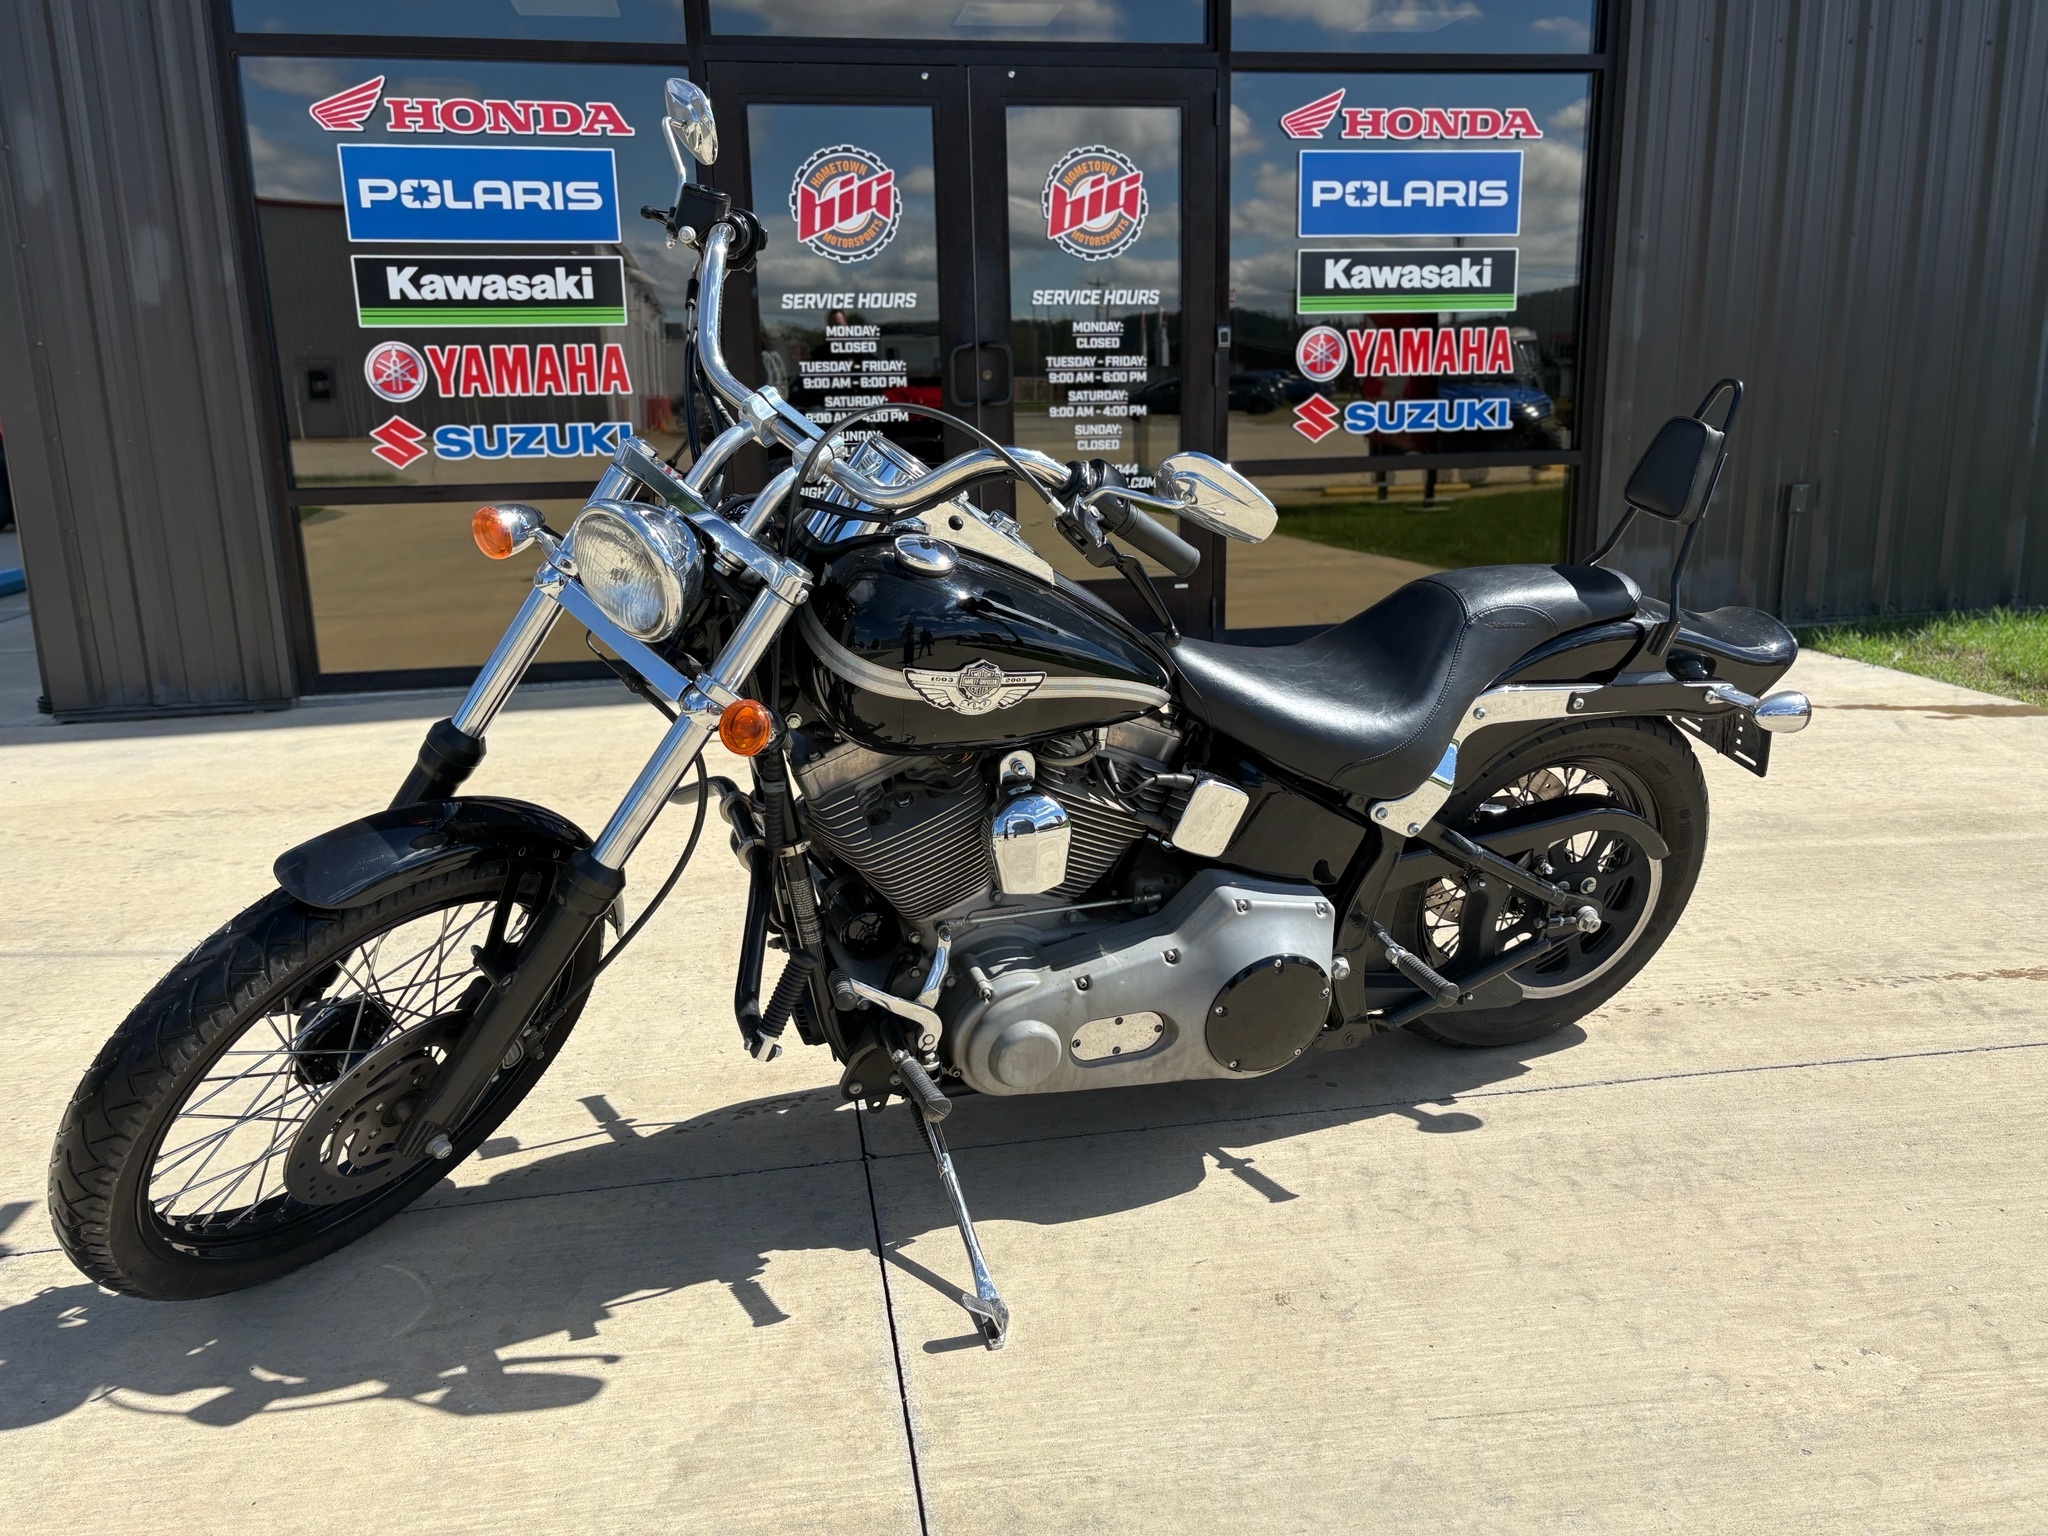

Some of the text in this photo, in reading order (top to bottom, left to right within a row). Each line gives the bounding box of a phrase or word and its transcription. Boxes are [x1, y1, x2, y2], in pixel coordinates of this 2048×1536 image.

[384, 98, 635, 137] HONDA
[1341, 107, 1543, 140] HONDA
[810, 160, 868, 189] HOMETOWN
[1062, 160, 1119, 187] HOMETOWN
[358, 178, 603, 211] POLARIS
[1312, 180, 1509, 208] POLARIS
[822, 218, 884, 249] MOTORSPORTS
[1071, 218, 1130, 246] MOTORSPORTS
[1324, 257, 1493, 290] Kawasaki
[386, 266, 595, 301] Kawasaki
[781, 292, 917, 309] SERVICE HOURS
[1032, 289, 1160, 305] SERVICE HOURS
[826, 325, 880, 337] MONDAY:
[1072, 321, 1124, 333] MONDAY:
[830, 341, 877, 354] CLOSED
[1076, 337, 1120, 349] CLOSED
[1347, 326, 1514, 377] YAMAHA
[799, 360, 852, 373] TUESDAY
[862, 360, 906, 372] FRIDAY:
[1046, 356, 1096, 368] TUESDAY
[1105, 355, 1147, 368] FRIDAY:
[424, 343, 633, 397] YAMAHA
[1048, 372, 1075, 384] 9:00
[1076, 372, 1094, 383] AM
[1103, 371, 1128, 383] 6:00
[1129, 371, 1147, 382] PM
[802, 377, 830, 389] 9:00
[832, 377, 851, 389] AM
[860, 377, 887, 388] 6:00
[889, 376, 908, 388] PM
[824, 395, 889, 408] SATURDAY:
[1068, 389, 1129, 402] SATURDAY:
[890, 411, 909, 422] PM
[1049, 406, 1075, 418] 9:00
[1076, 406, 1094, 417] AM
[1103, 405, 1128, 417] 4:00
[1129, 405, 1147, 416] PM
[1344, 398, 1512, 434] SUZUKI
[1074, 423, 1122, 436] SUNDAY:
[1077, 438, 1120, 451] CLOSED
